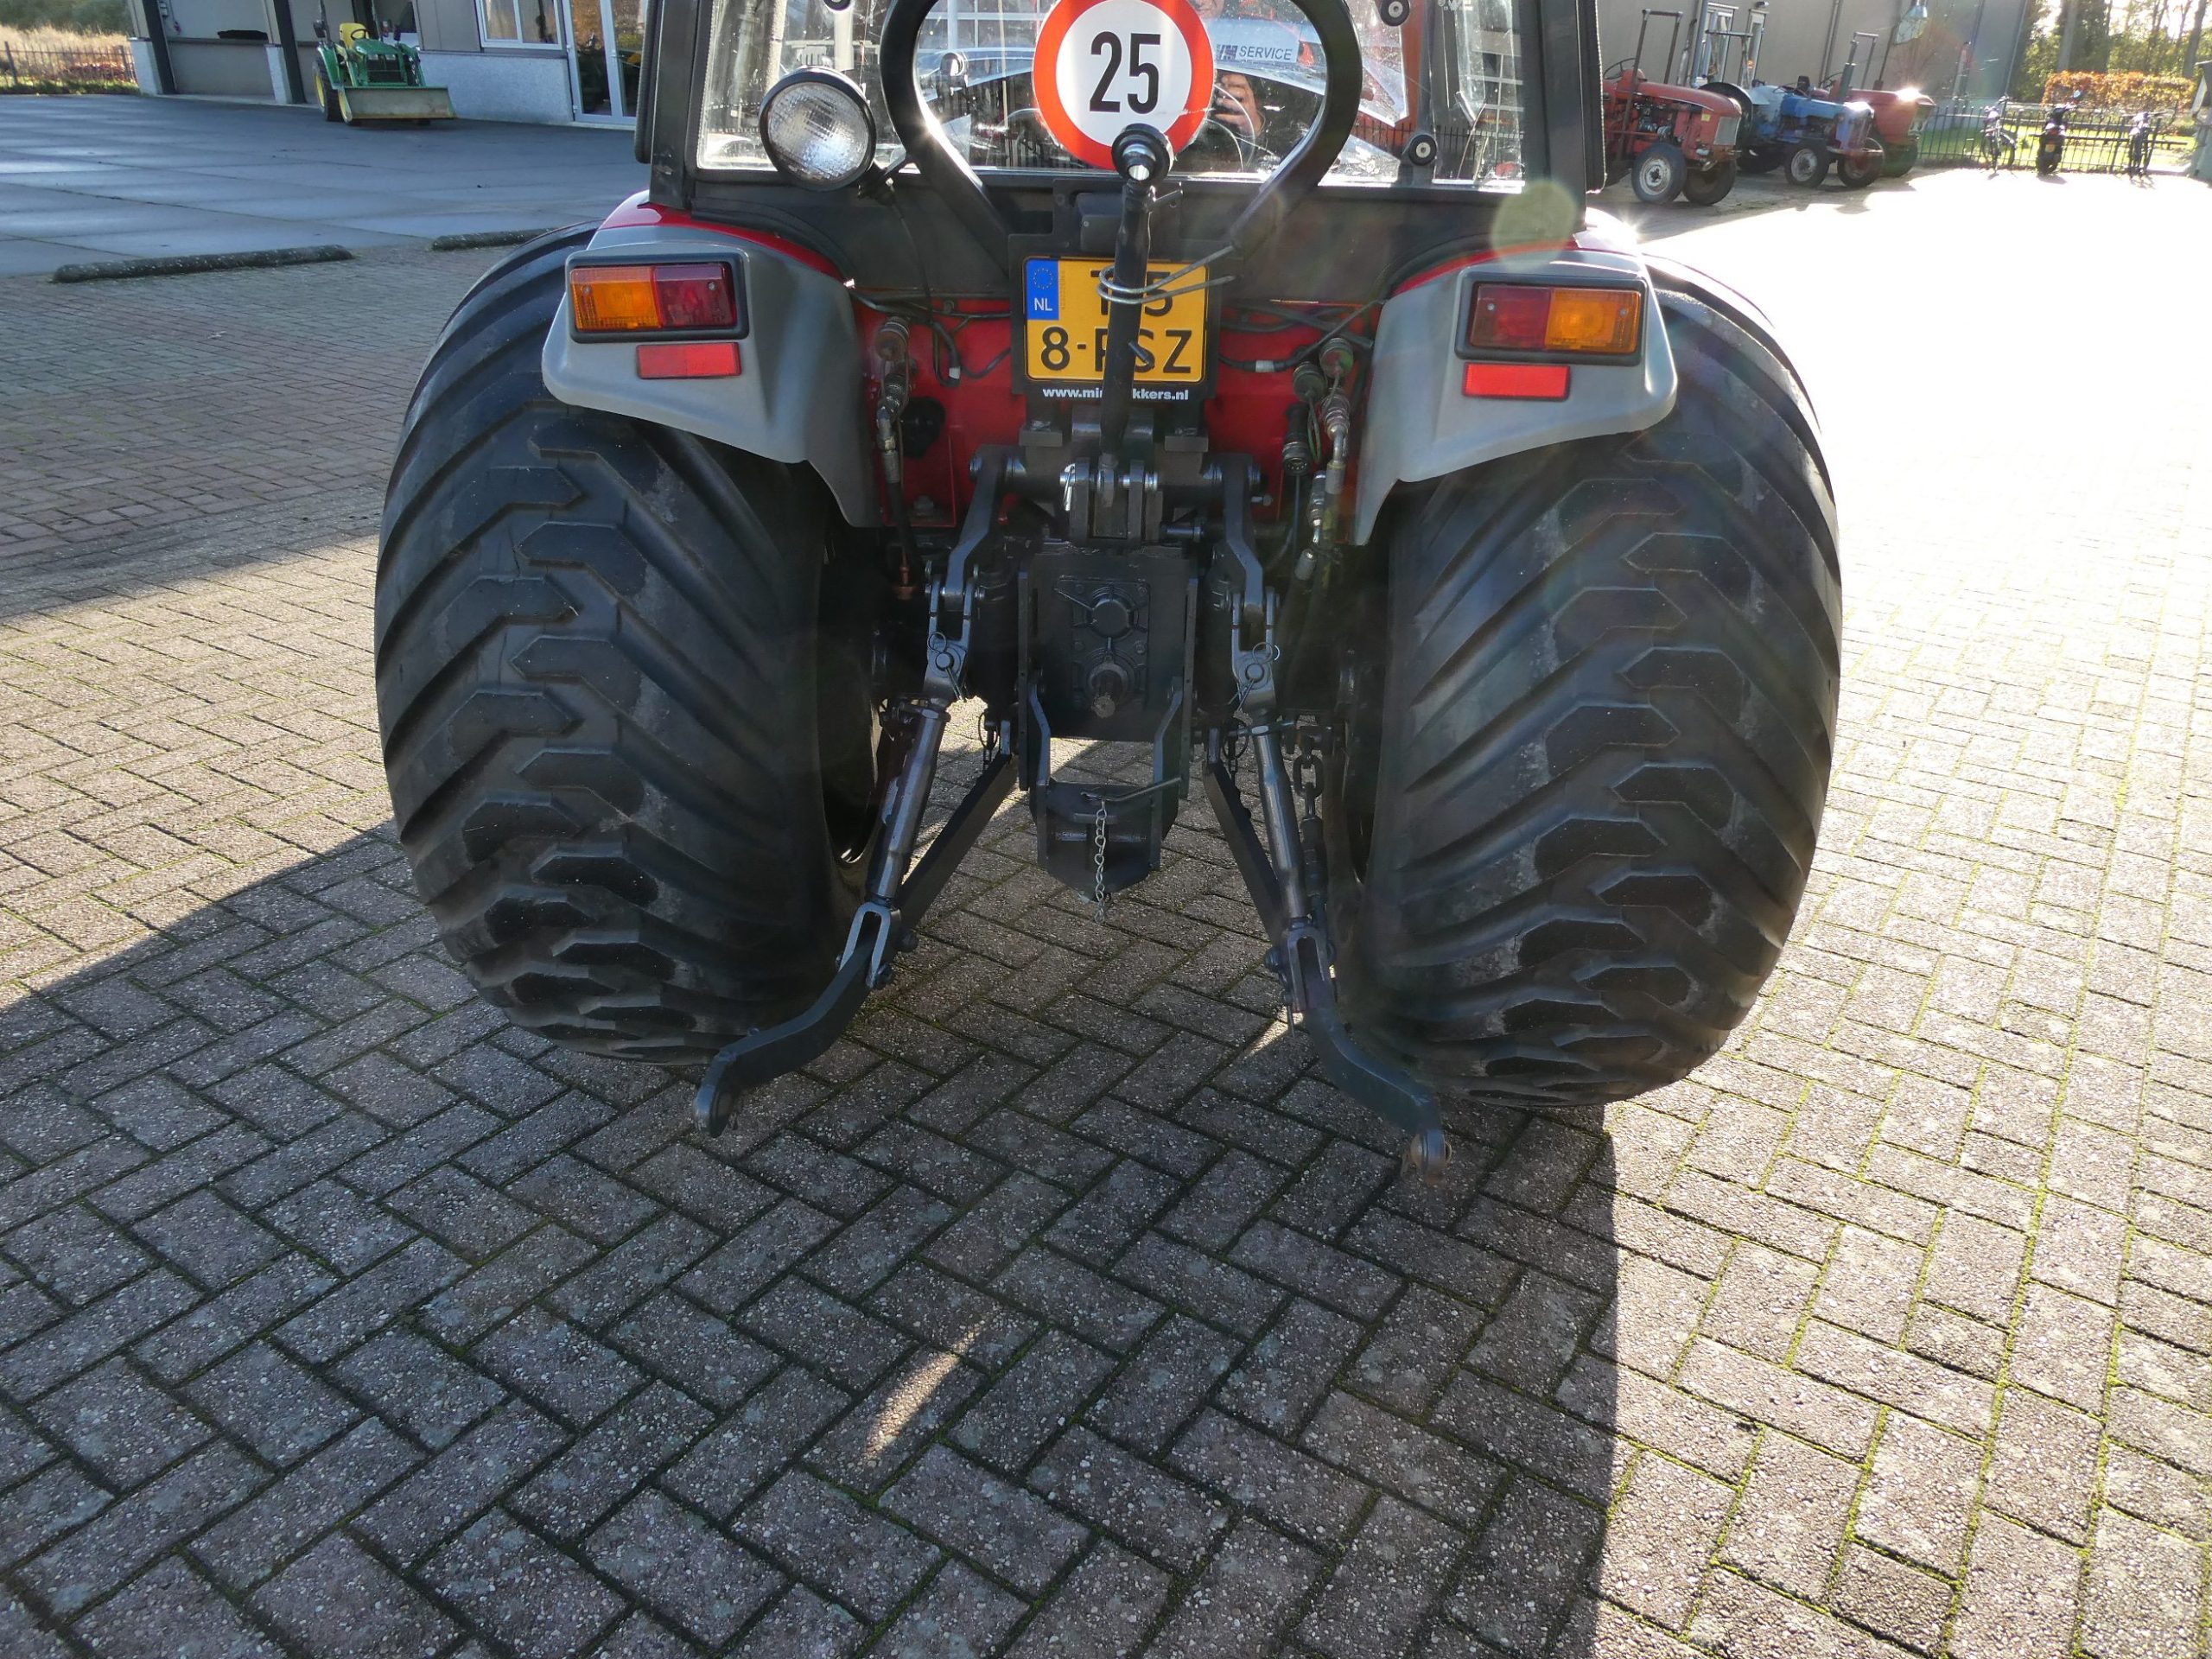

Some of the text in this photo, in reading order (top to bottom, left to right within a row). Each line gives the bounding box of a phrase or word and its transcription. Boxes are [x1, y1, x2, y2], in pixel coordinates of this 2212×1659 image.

[1238, 45, 1294, 61] SERVICE
[1089, 30, 1161, 115] 25
[1033, 297, 1053, 312] NL
